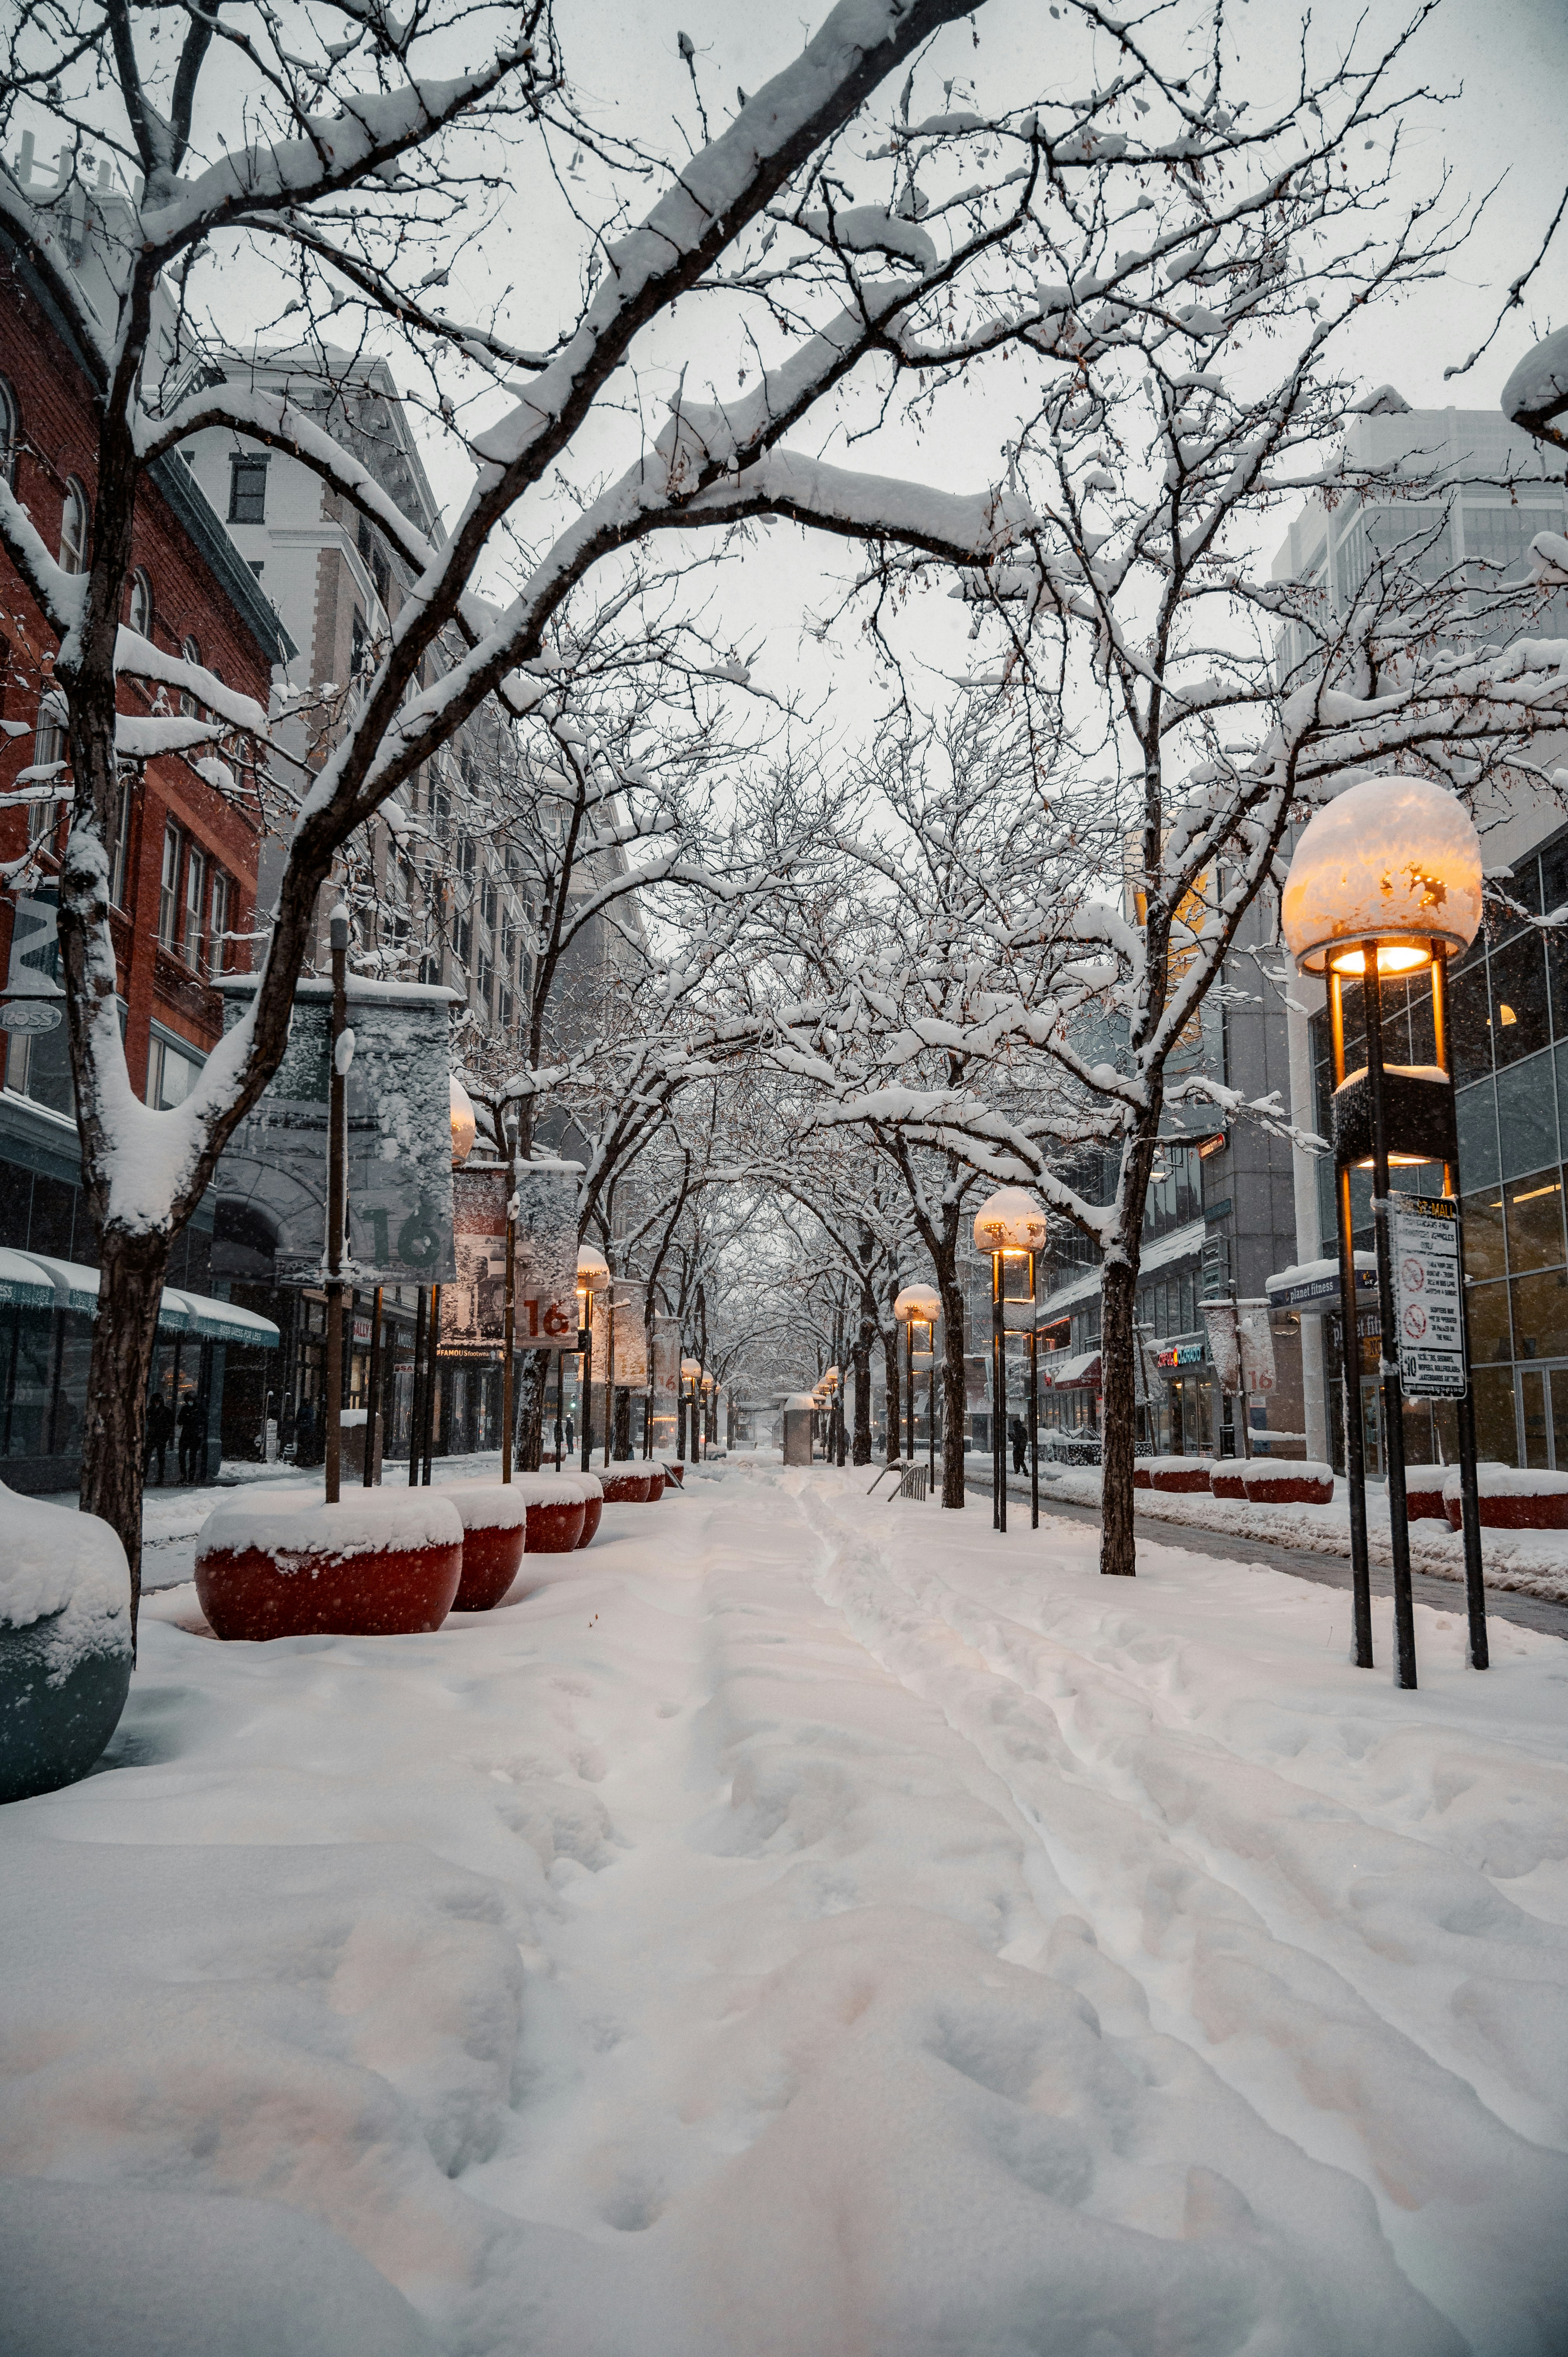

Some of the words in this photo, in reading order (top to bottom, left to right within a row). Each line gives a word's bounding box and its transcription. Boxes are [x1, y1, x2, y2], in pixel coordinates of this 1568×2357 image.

[362, 1206, 440, 1269] 16
[0, 1284, 13, 1298] ESS
[1290, 1288, 1310, 1304] planet
[1311, 1282, 1333, 1295] fitness
[523, 1299, 569, 1337] 16
[252, 1332, 262, 1341] LESS
[657, 1375, 676, 1391] 16
[1248, 1369, 1273, 1390] 16
